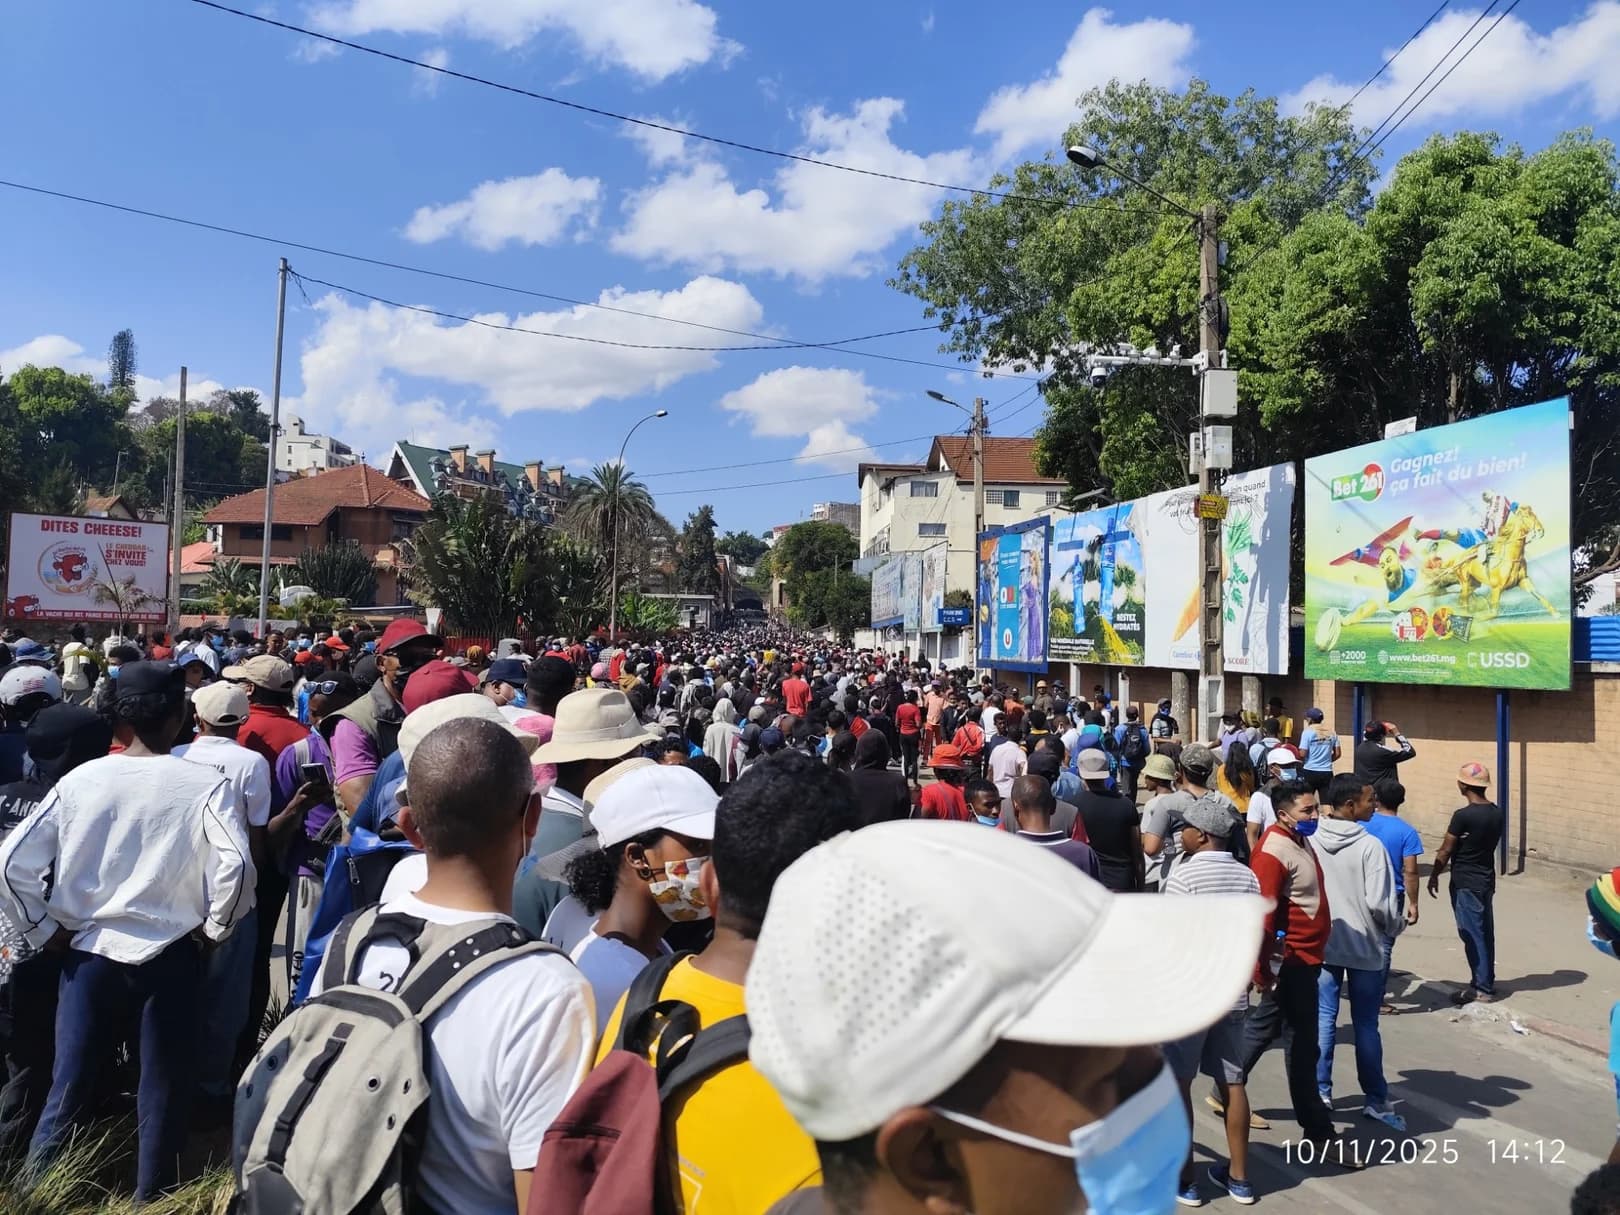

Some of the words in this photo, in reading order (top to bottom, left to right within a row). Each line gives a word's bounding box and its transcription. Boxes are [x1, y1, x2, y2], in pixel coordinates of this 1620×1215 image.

[1391, 448, 1458, 473] Gagnez!
[1390, 478, 1409, 496] ça
[1413, 467, 1442, 488] fait
[1448, 464, 1472, 480] du
[1477, 451, 1526, 477] bien!
[1243, 480, 1266, 492] quand
[1334, 479, 1357, 497] Bet
[1360, 472, 1383, 493] 261
[41, 519, 79, 534] DITES
[84, 522, 142, 538] CHEEESE!
[106, 550, 146, 560] S'INVITE
[1117, 613, 1136, 622] RESTEZ
[1341, 650, 1366, 660] +2000
[1389, 653, 1456, 665] www.bet261.mg
[1481, 652, 1530, 668] USSD
